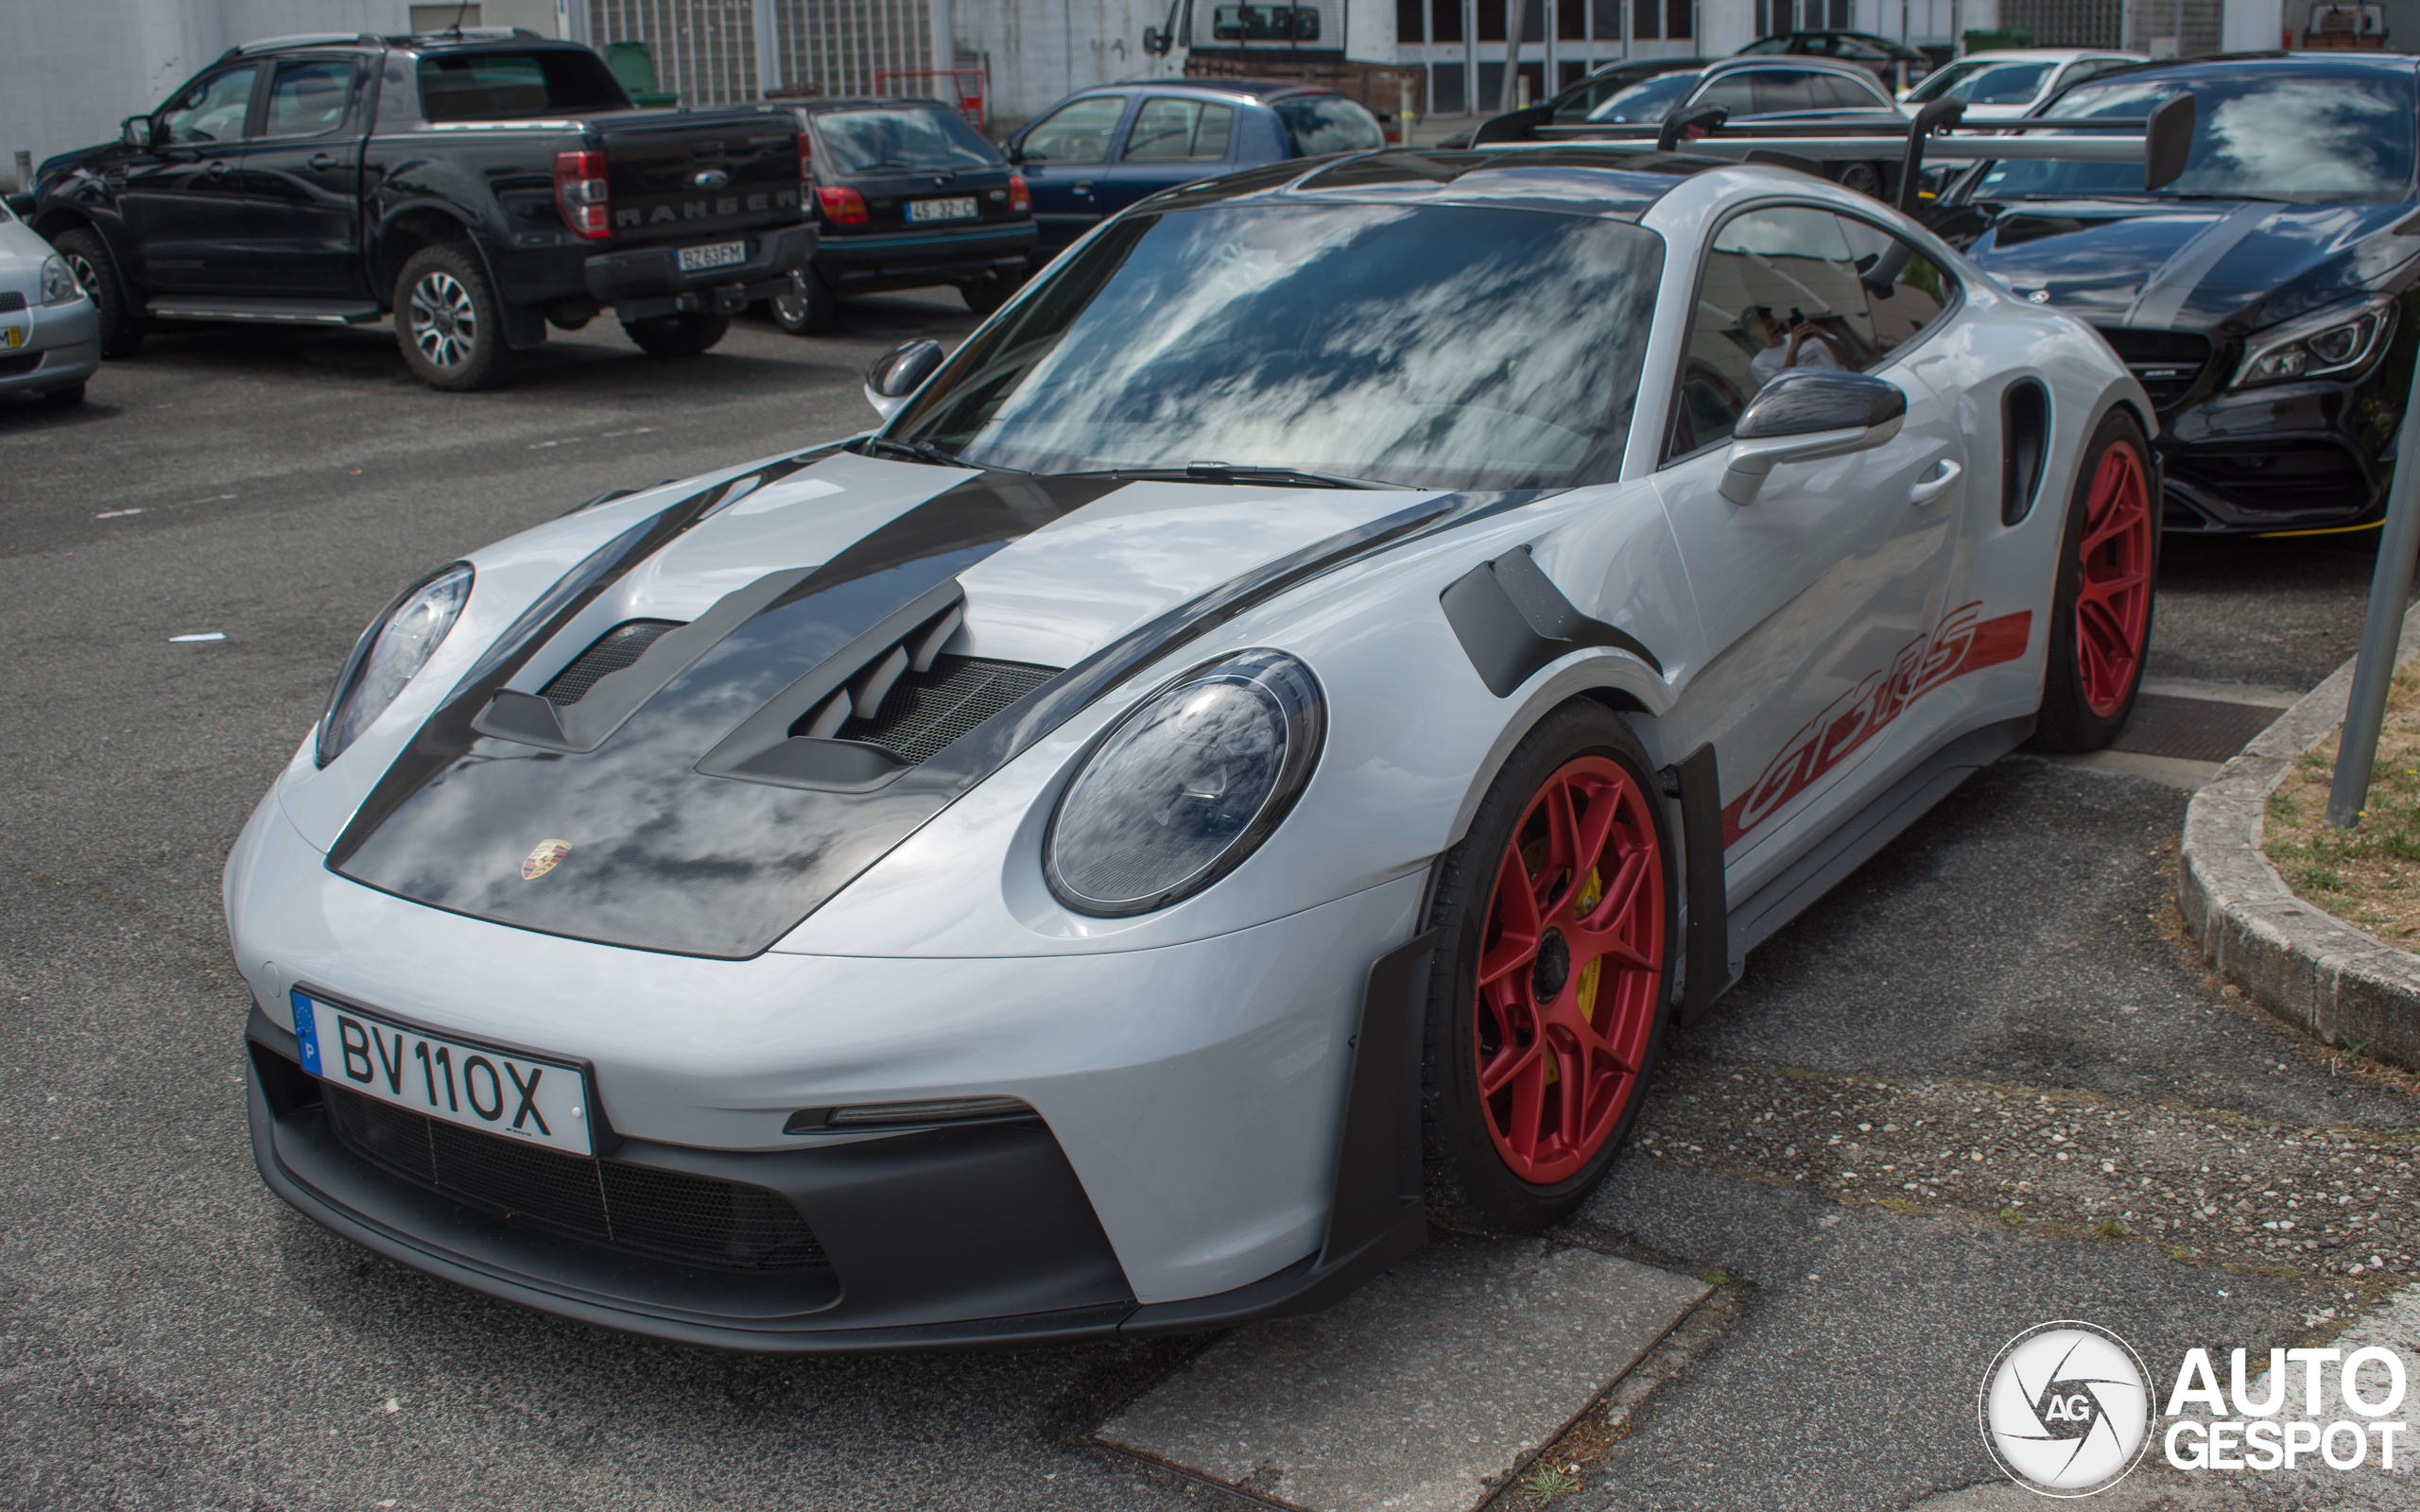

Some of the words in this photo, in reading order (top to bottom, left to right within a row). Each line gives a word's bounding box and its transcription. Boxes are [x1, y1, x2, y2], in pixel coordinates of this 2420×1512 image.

[616, 190, 798, 228] RANGER
[304, 1041, 315, 1059] P
[337, 1014, 552, 1136] BV11OX
